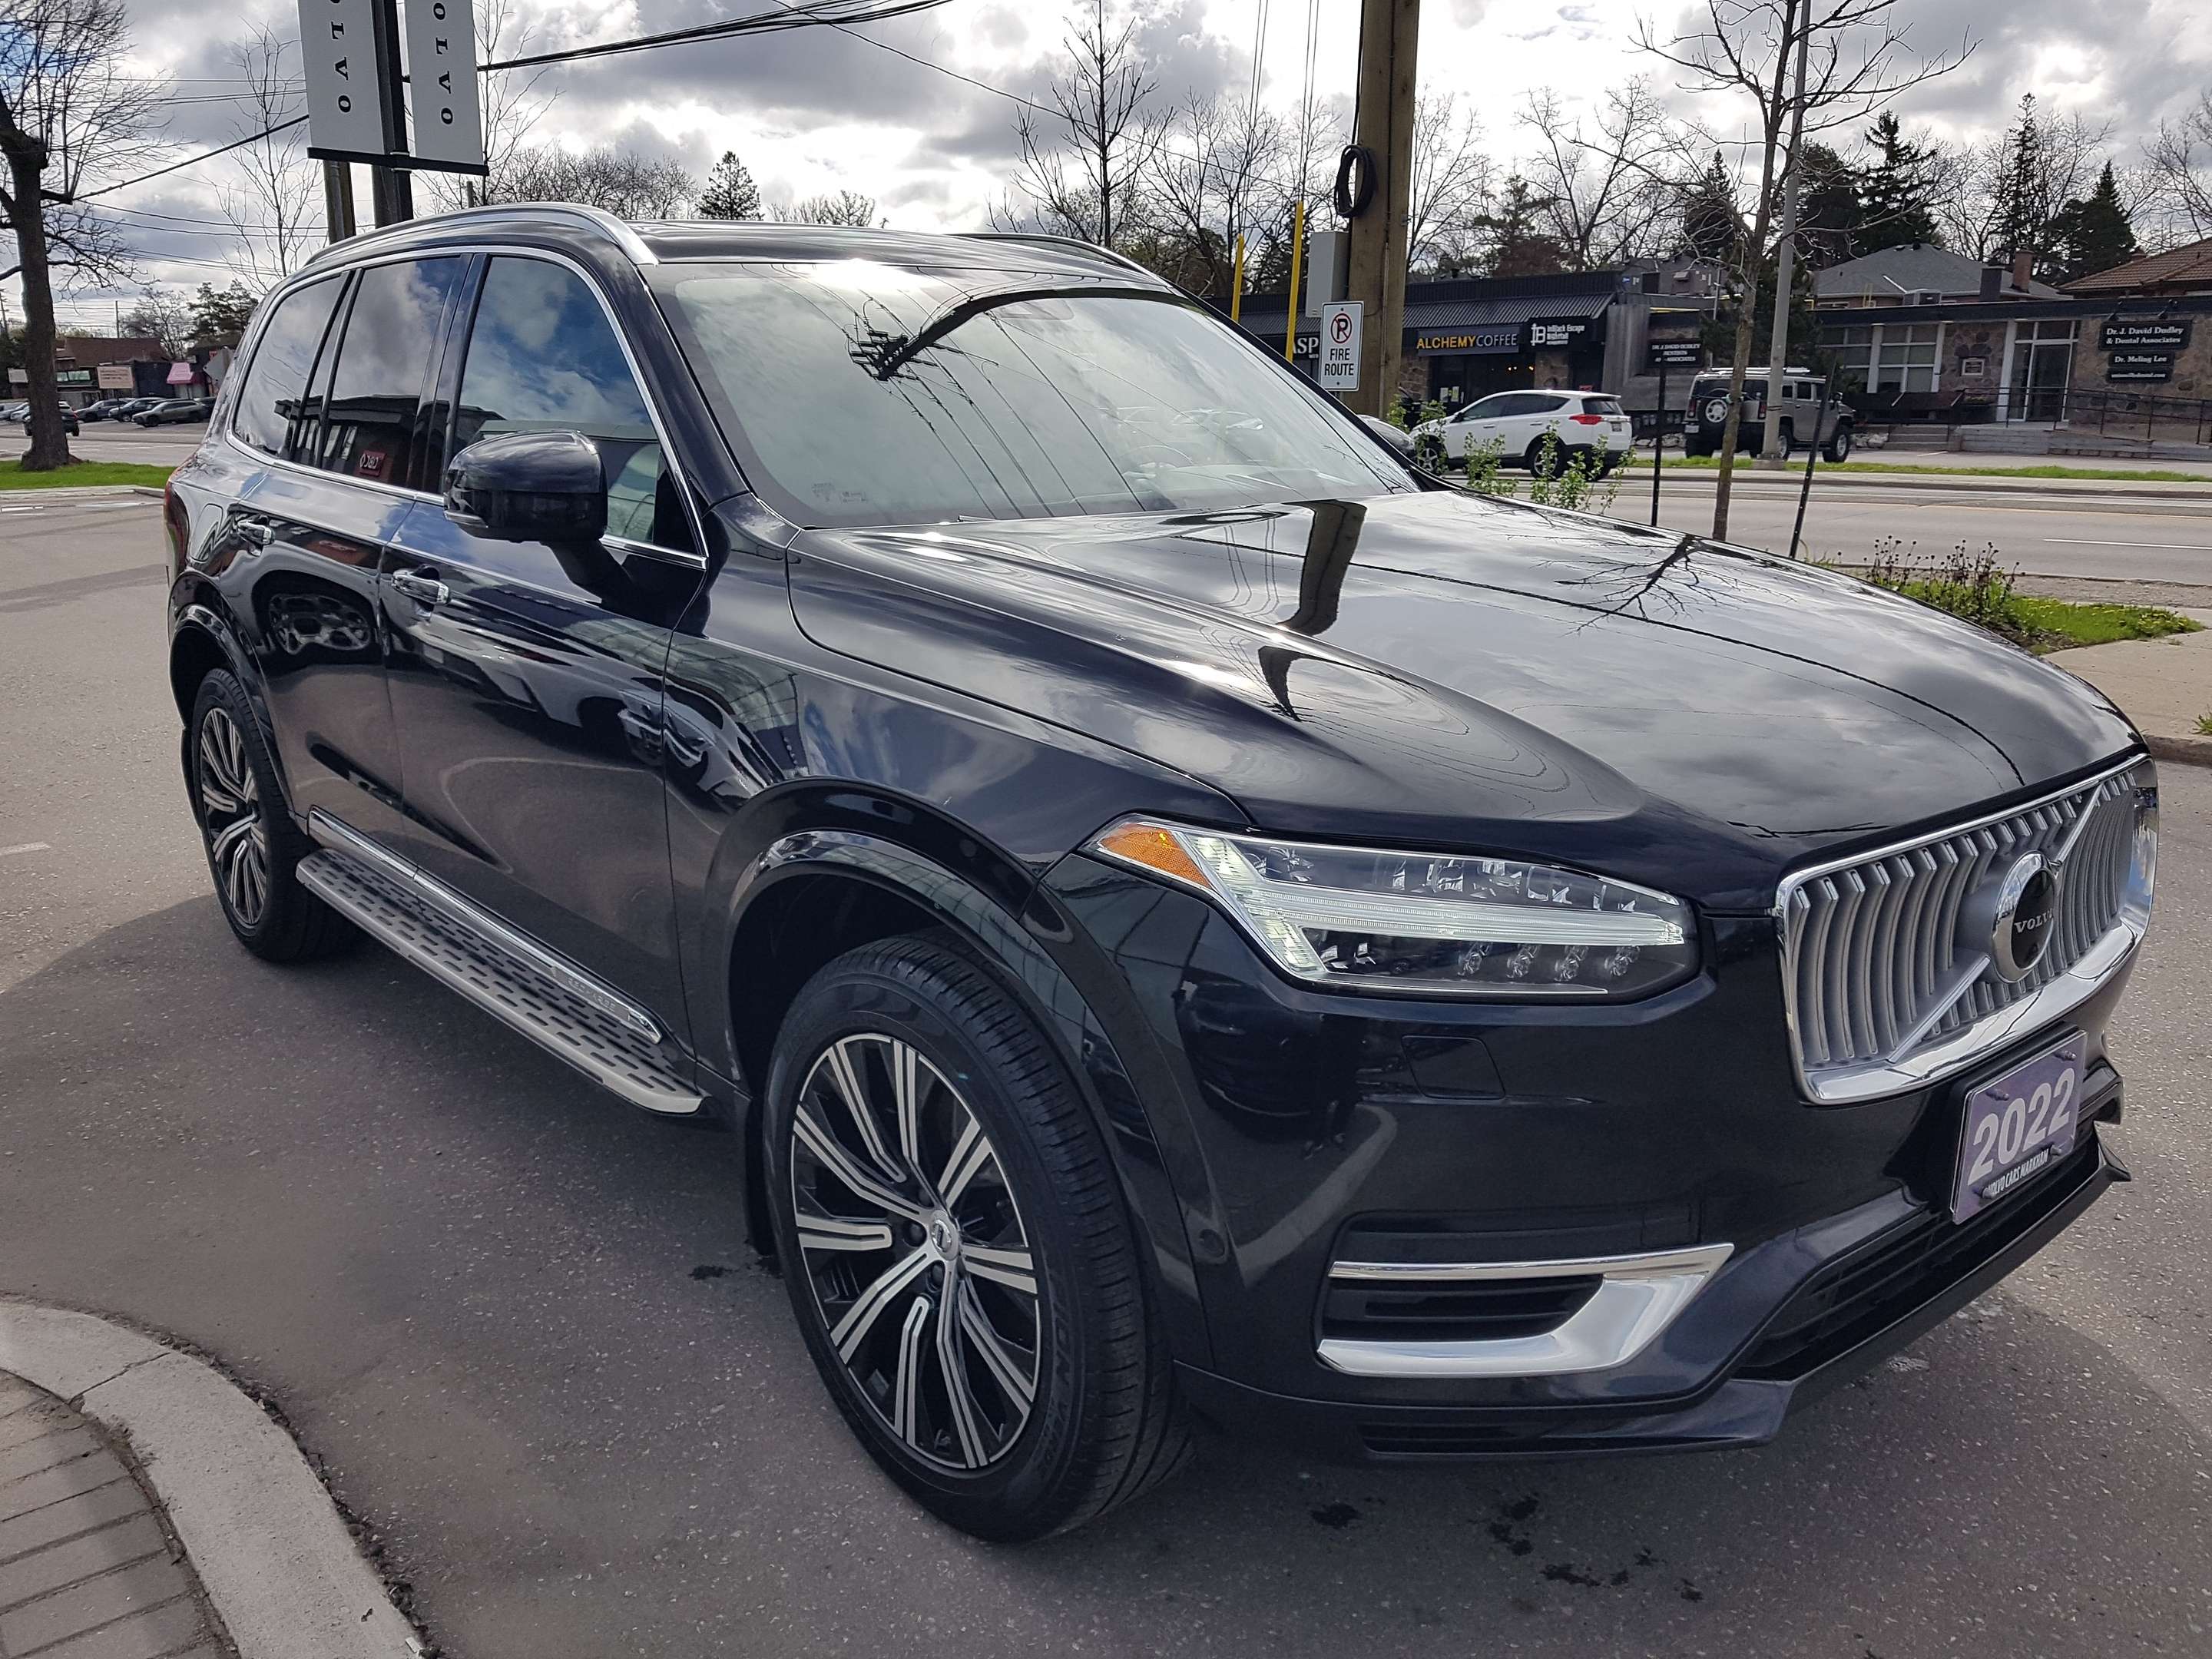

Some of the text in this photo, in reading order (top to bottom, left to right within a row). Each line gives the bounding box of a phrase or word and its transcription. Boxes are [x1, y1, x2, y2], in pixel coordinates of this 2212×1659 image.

[330, 0, 351, 113] LVO
[1293, 337, 1319, 354] SP
[1330, 348, 1350, 361] FIRE
[1324, 363, 1354, 376] ROUTE
[1968, 1068, 2075, 1186] 2022
[2005, 1166, 2021, 1187] CARS
[2020, 1148, 2049, 1179] MARKHAM
